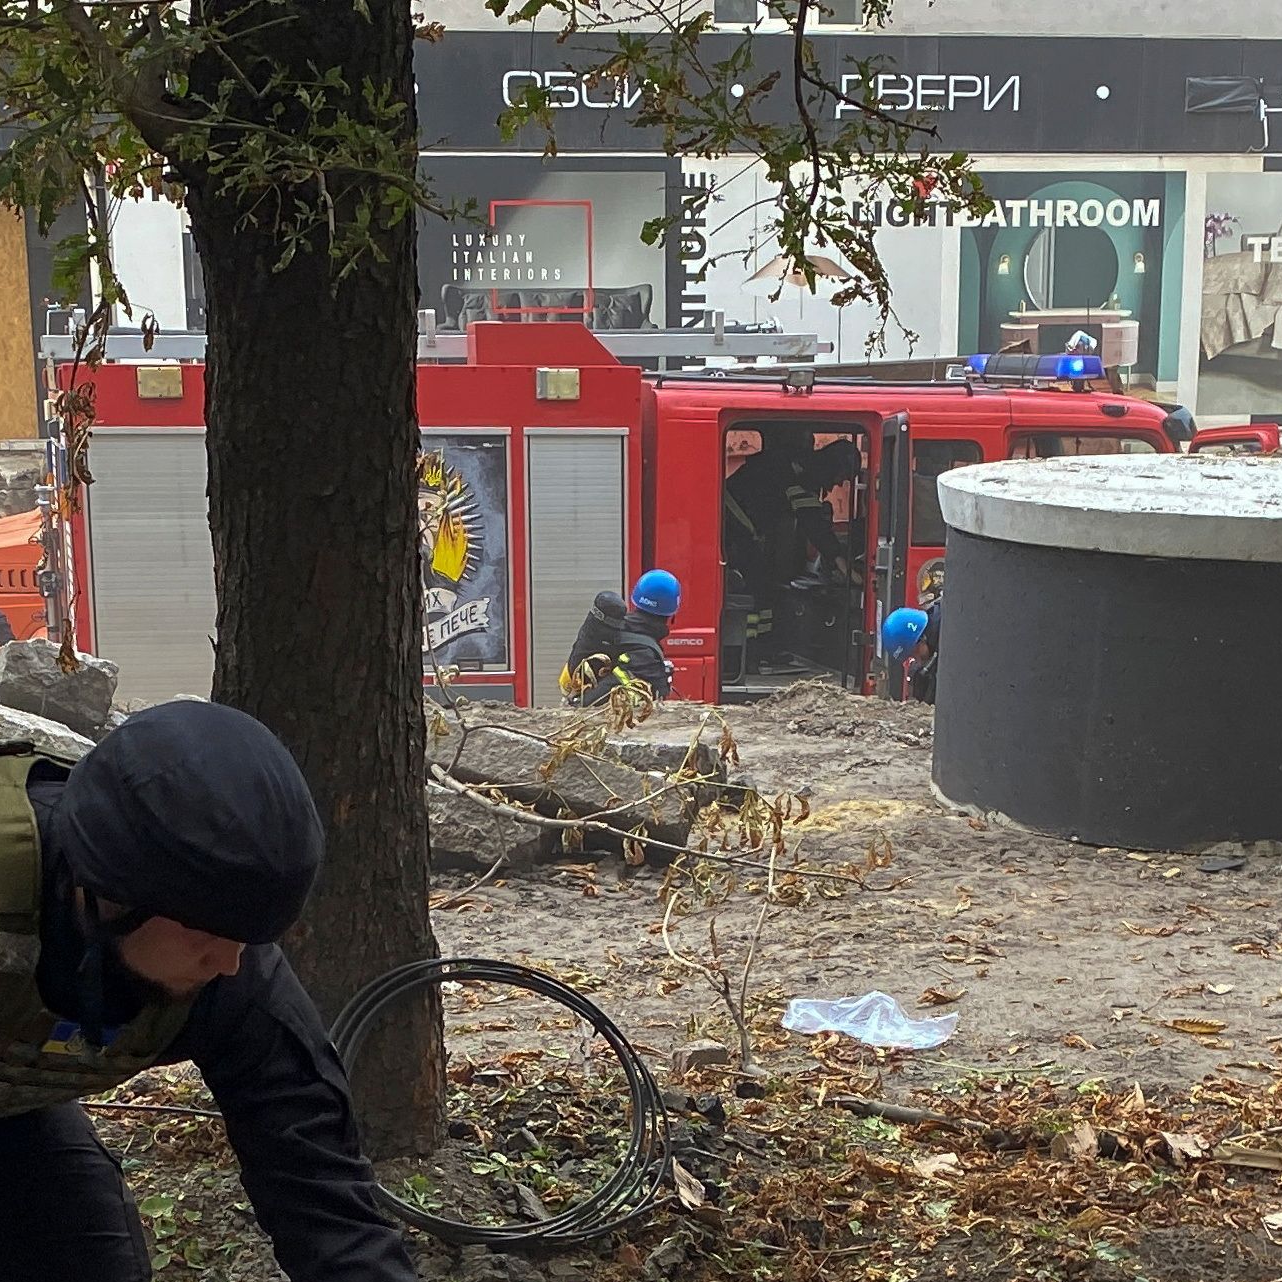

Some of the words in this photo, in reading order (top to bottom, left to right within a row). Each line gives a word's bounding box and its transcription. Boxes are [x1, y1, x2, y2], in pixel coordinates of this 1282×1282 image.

[835, 74, 1020, 119] ДВЕРИ
[853, 200, 958, 227] LIGHT
[452, 233, 526, 247] LUXURY
[452, 250, 533, 264] ITALIAN
[453, 268, 561, 281] INTERIORS
[440, 605, 478, 639] ПЕЧЕ
